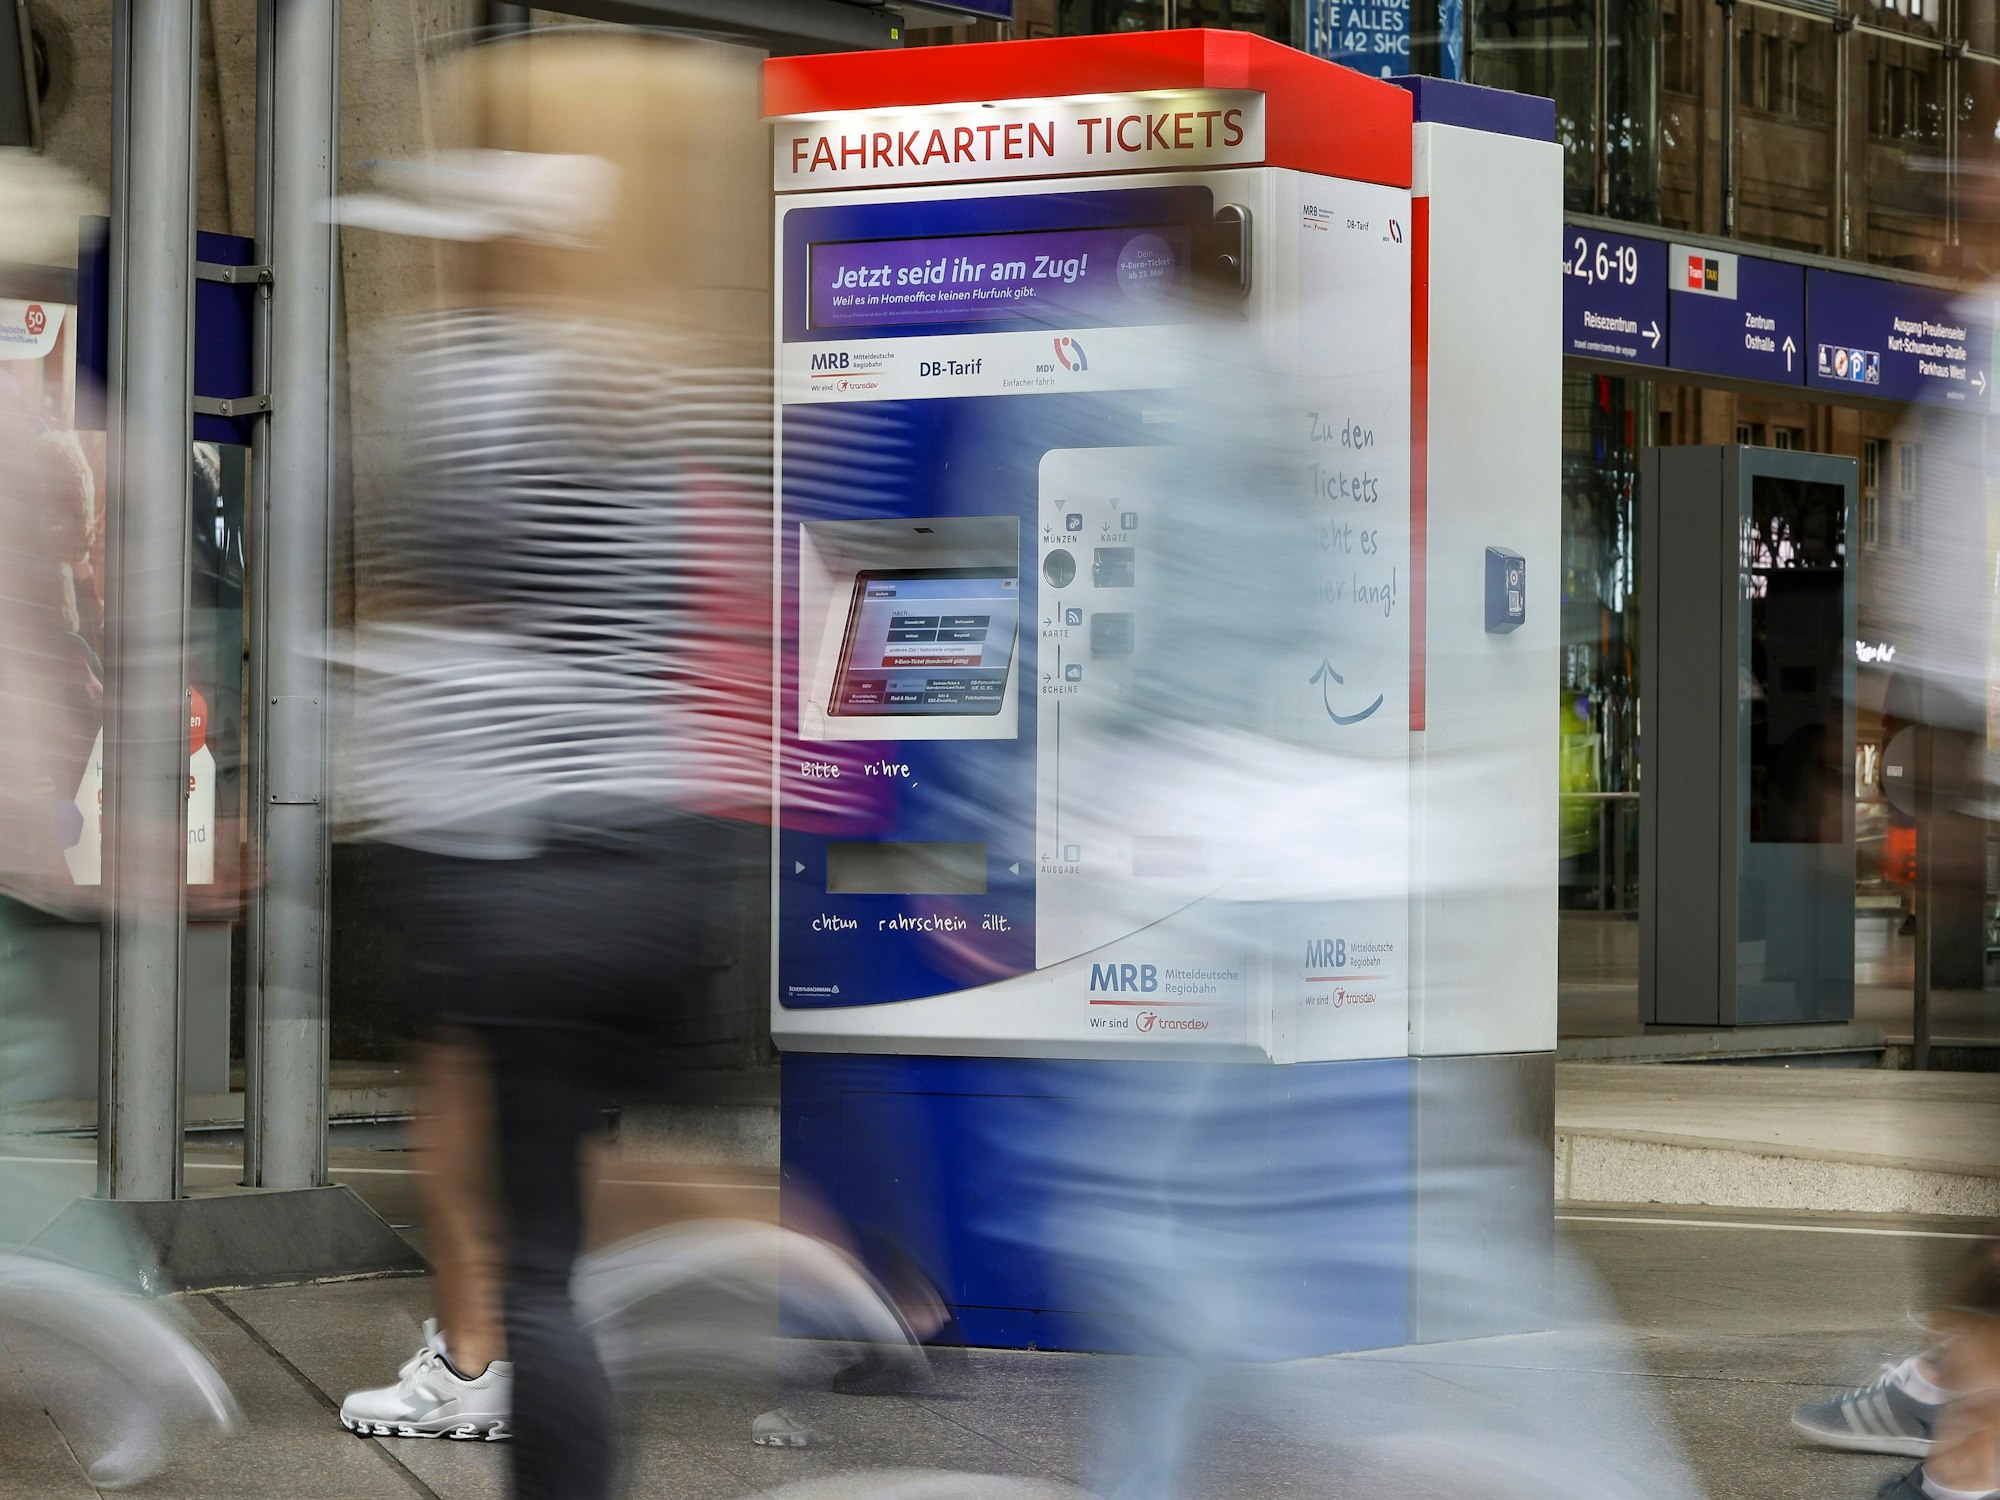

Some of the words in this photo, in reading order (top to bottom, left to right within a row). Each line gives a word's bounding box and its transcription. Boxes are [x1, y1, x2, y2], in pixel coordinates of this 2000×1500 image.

[1347, 9, 1404, 32] ALLES
[792, 121, 1055, 174] FAHRKARTEN
[1077, 108, 1244, 155] TICKETS
[1303, 204, 1318, 216] MRB
[1346, 219, 1370, 232] DB-Tarif
[1137, 250, 1154, 258] Dein
[831, 265, 892, 289] Jetzt
[896, 258, 947, 285] seid
[951, 256, 986, 283] ihr
[990, 261, 1026, 281] am
[1032, 254, 1088, 283] Zug!
[1120, 258, 1170, 270] 9-Euro-Ticket
[1562, 259, 1572, 275] nd
[1128, 272, 1138, 280] ab
[1150, 268, 1164, 278] Mai
[1689, 266, 1703, 279] Tram
[1706, 268, 1718, 281] TAXI
[832, 295, 853, 306] Weil
[855, 297, 866, 306] es
[867, 294, 879, 304] im
[881, 290, 936, 304] Homeoffice
[938, 290, 970, 302] keinen
[972, 286, 1012, 300] Flurfunk
[1014, 286, 1037, 300] gibt.
[28, 310, 44, 328] 50
[1584, 310, 1638, 334] Reisezentrum
[1746, 312, 1776, 331] Zentrum
[1894, 317, 1922, 338] Ausgang
[1922, 320, 1967, 342] Preußenseite/
[1745, 334, 1776, 352] Osthalle
[1888, 336, 1967, 361] Kurt-Schumacher-Straße
[811, 352, 850, 370] MRB
[854, 352, 894, 360] Mitteldeutsche
[854, 360, 883, 369] Regiobahn
[920, 358, 982, 377] DB-Tarif
[1036, 364, 1055, 373] MDV
[1919, 360, 1950, 378] Parkhaus
[1950, 363, 1966, 380] West
[849, 380, 878, 390] transdev
[1003, 378, 1034, 388] Einfacher
[1307, 412, 1333, 442] Zu
[1342, 417, 1374, 450] den
[1307, 462, 1378, 504] Tickets
[1043, 534, 1078, 544] MÜNZEN
[1101, 534, 1128, 542] KARTE
[1360, 529, 1378, 556] es
[1353, 566, 1398, 618] lang!
[1042, 630, 1069, 638] KARTE
[1042, 686, 1078, 694] SCHEINE
[800, 761, 840, 778] Bitte
[1041, 865, 1080, 874] AUSGABE
[1305, 938, 1346, 968] MRB
[1350, 941, 1394, 953] Mitteldeutsche
[1350, 955, 1381, 970] Regiobahn
[1090, 963, 1158, 992] MRB
[1165, 968, 1239, 981] Mitteldeutsche
[1165, 983, 1217, 996] Regiobahn
[1306, 996, 1316, 1006] Wir
[1317, 994, 1329, 1006] sind
[1346, 992, 1376, 1004] transdev
[1090, 1018, 1106, 1028] Wir
[1109, 1017, 1129, 1029] sind
[1158, 1018, 1209, 1030] transdev
